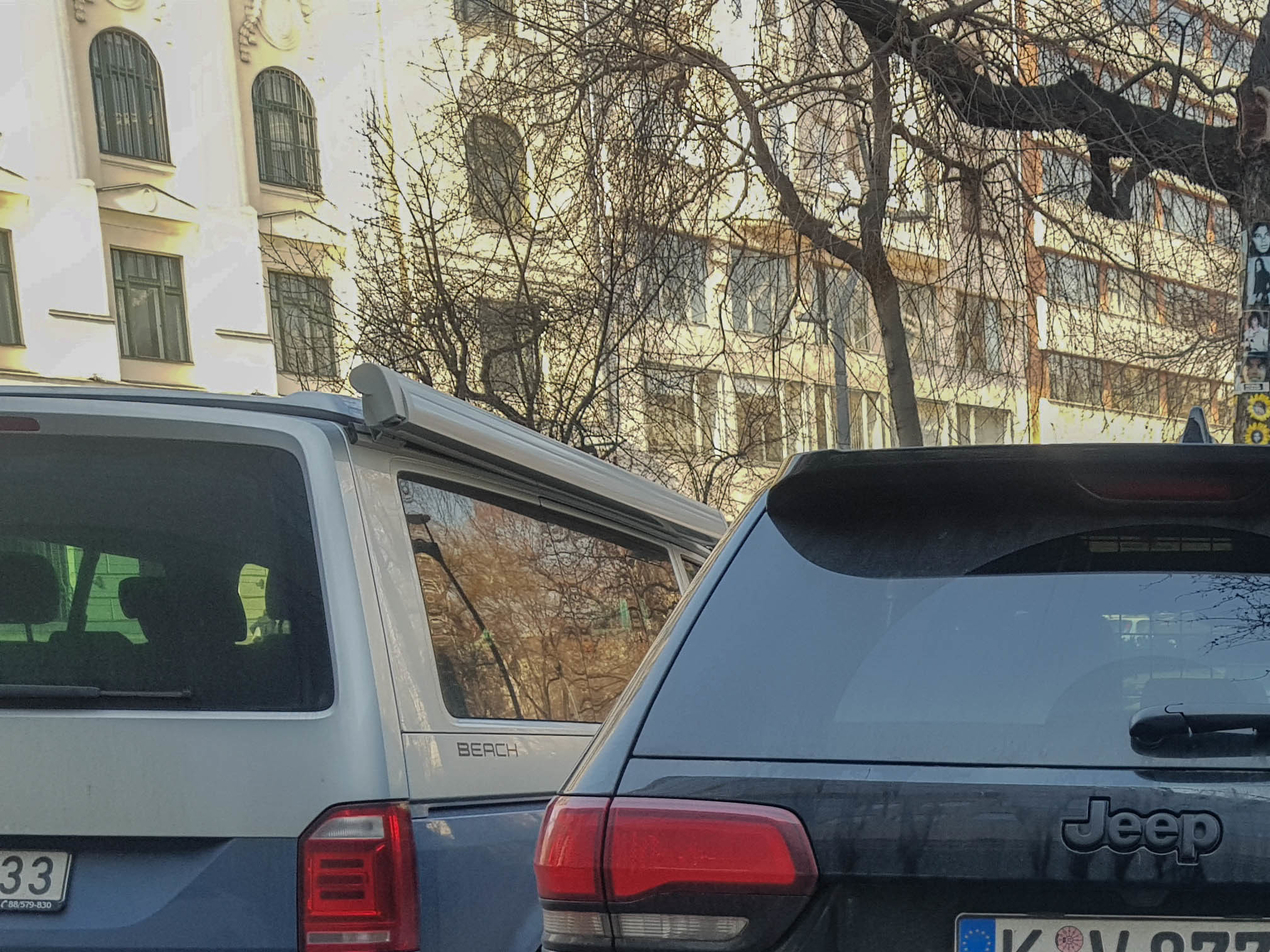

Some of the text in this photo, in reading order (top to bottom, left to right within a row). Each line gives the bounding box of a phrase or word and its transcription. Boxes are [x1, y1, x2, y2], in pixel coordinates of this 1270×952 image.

[457, 742, 519, 757] BEACH
[1061, 796, 1222, 866] Jeep
[0, 855, 53, 895] 33
